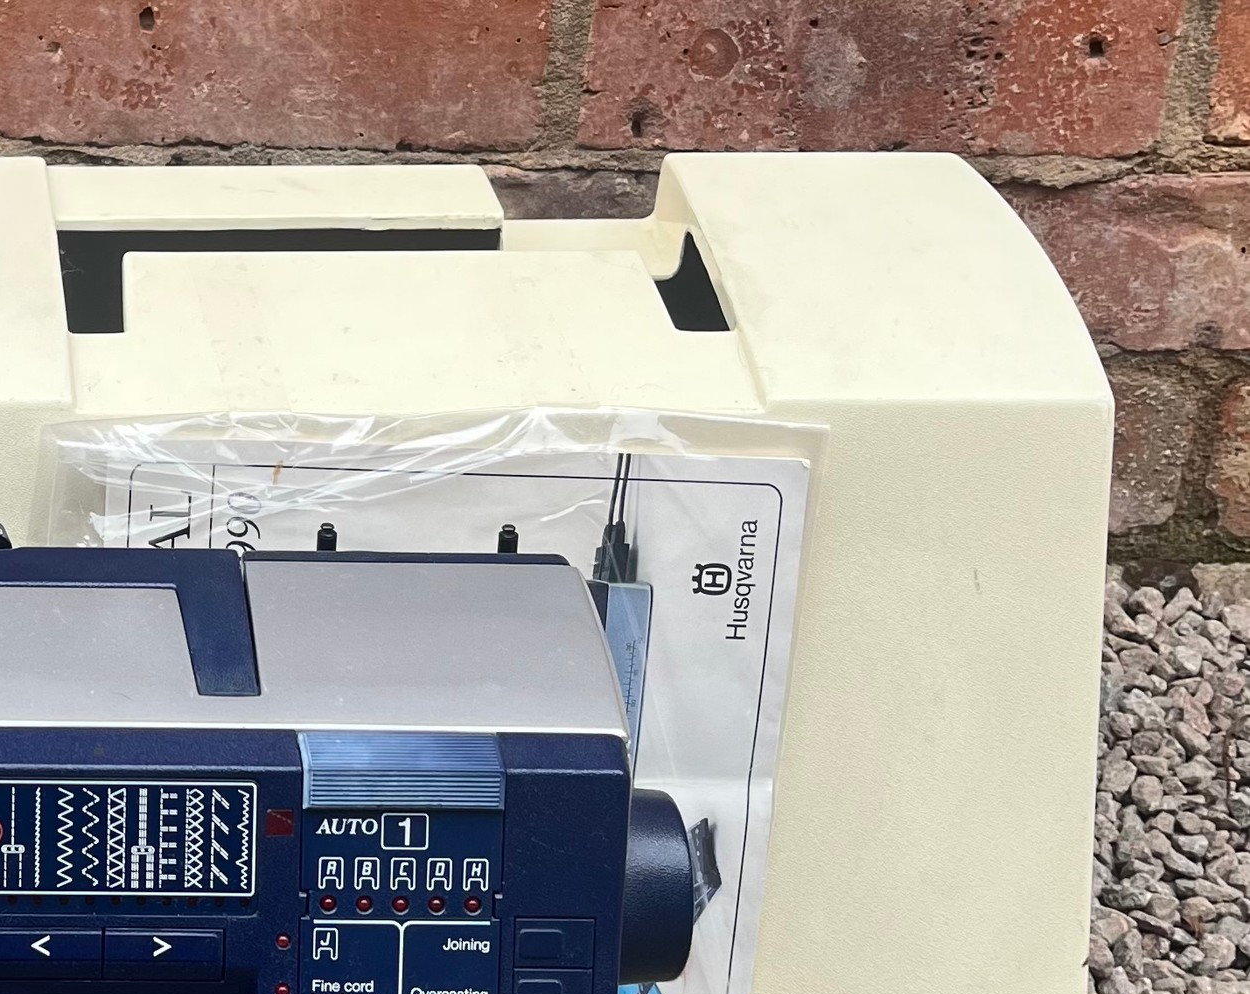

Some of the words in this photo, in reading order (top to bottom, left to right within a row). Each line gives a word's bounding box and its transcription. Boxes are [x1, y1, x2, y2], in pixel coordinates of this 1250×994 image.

[725, 519, 758, 640] Husqvarna
[316, 819, 378, 834] AUTO
[399, 818, 410, 846] 1
[327, 863, 336, 874] A
[362, 863, 371, 875] B
[471, 865, 481, 876] H
[443, 938, 490, 953] Joining
[312, 980, 340, 992] Fine
[344, 980, 374, 992] cord
